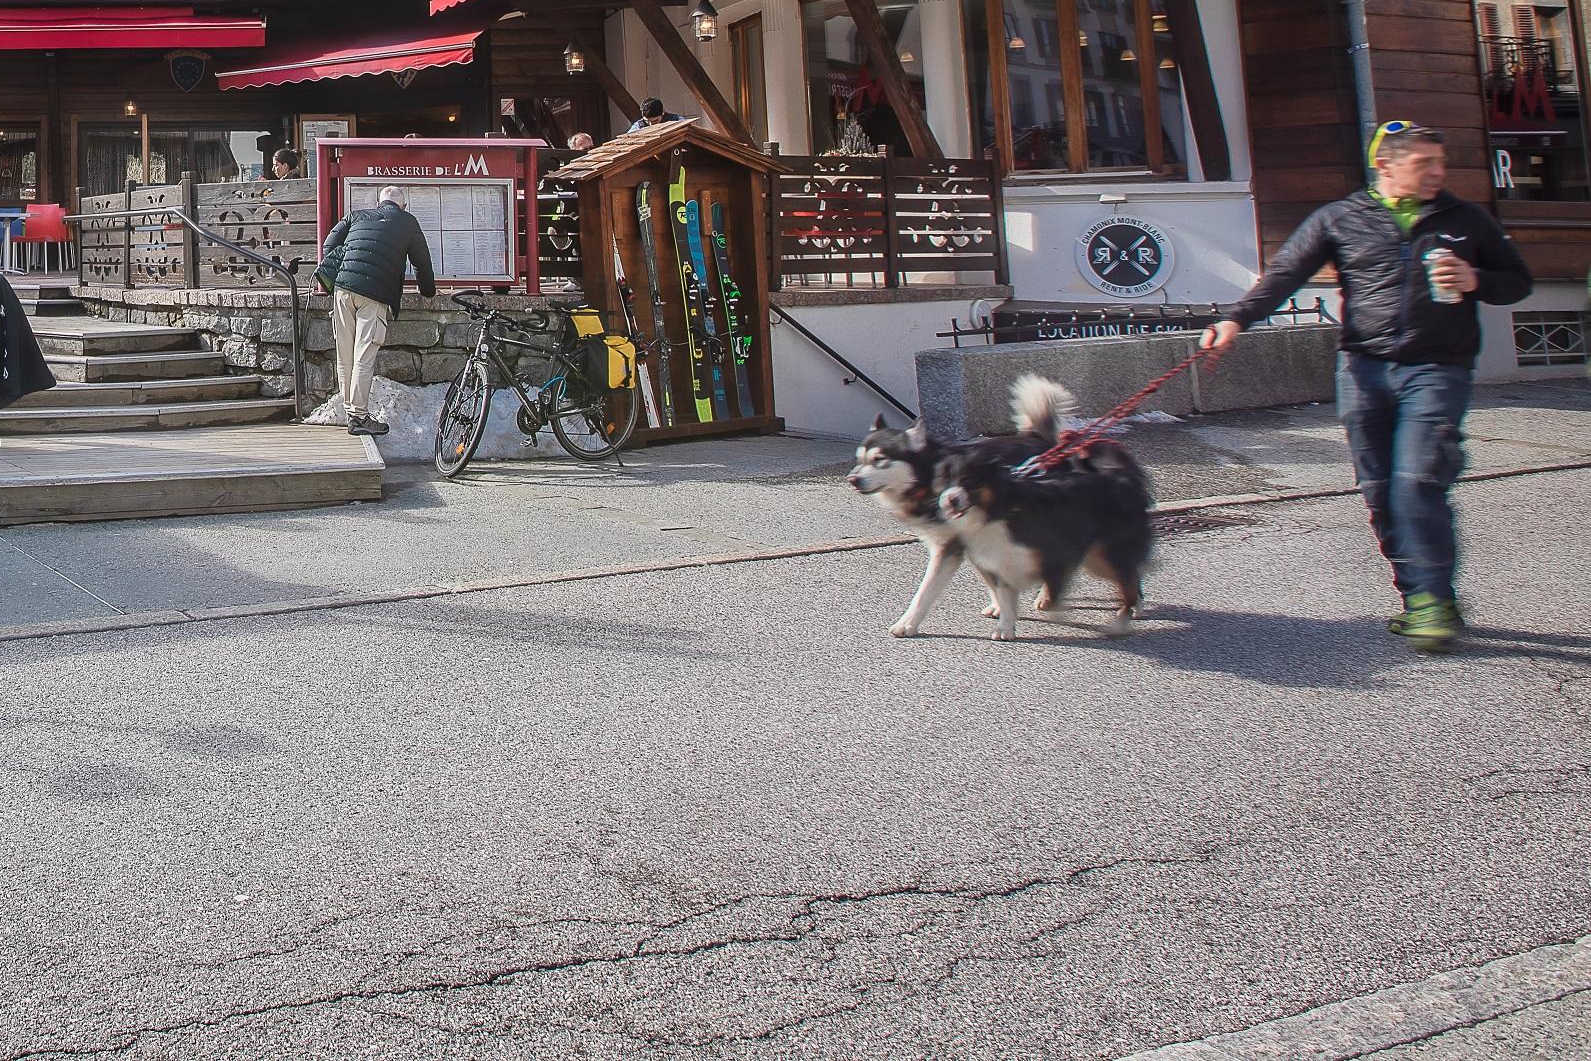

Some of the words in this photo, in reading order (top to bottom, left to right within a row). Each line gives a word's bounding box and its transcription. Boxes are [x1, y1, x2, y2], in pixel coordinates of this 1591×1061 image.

[367, 166, 432, 176] BRASSERIE
[435, 166, 451, 176] DE
[454, 154, 489, 176] L'M
[1081, 218, 1116, 244] CHAMONIX
[1117, 217, 1165, 244] MONT-BLANC
[1119, 250, 1129, 261] &
[1100, 281, 1124, 294] RENT
[1125, 286, 1131, 294] &
[1134, 281, 1153, 293] RIDE
